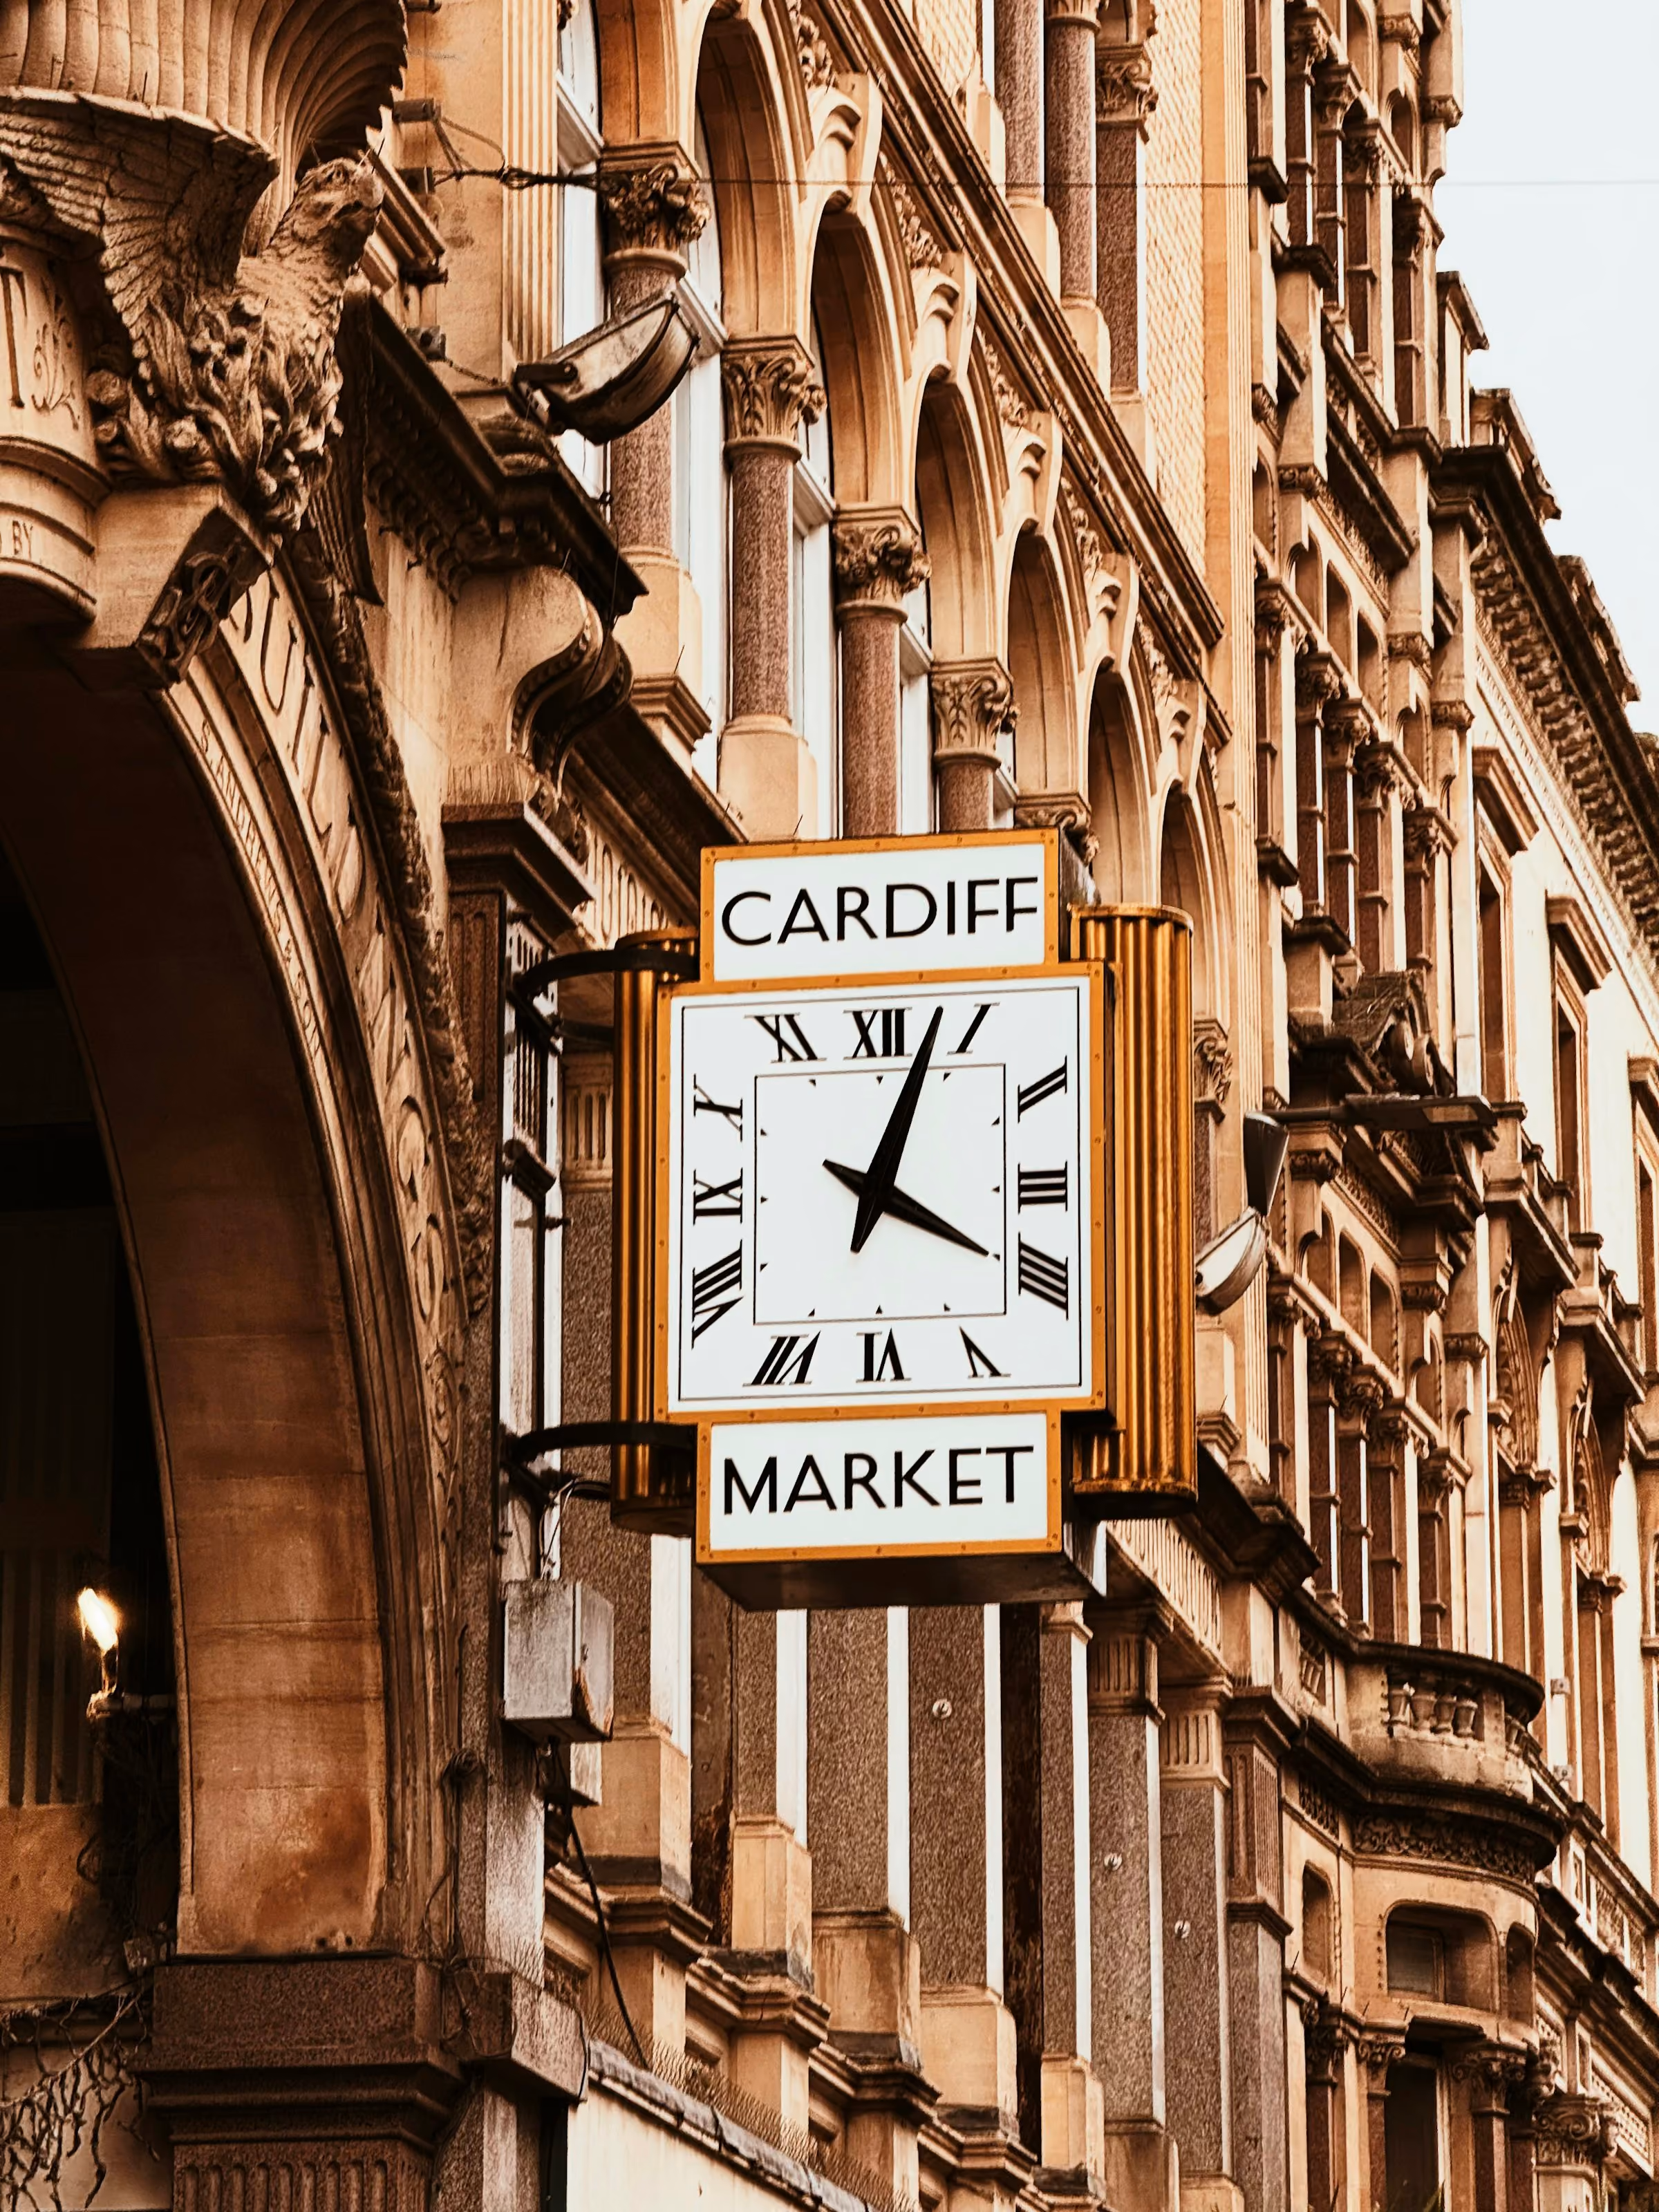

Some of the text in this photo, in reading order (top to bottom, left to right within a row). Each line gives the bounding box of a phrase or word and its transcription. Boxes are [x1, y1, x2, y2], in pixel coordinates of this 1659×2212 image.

[722, 877, 1038, 946] CARDIFF
[744, 1012, 827, 1063] XI
[843, 1007, 912, 1060] XII
[946, 1002, 1000, 1056] I
[693, 1074, 743, 1142] X
[1018, 1055, 1067, 1123] II
[693, 1167, 743, 1226] IX
[1018, 1160, 1068, 1215] III
[691, 1239, 744, 1350] VIII
[1018, 1232, 1069, 1321] IIII
[742, 1330, 821, 1387] VII
[856, 1328, 911, 1383] VI
[959, 1326, 1011, 1378] V
[724, 1445, 1033, 1515] MARKET
